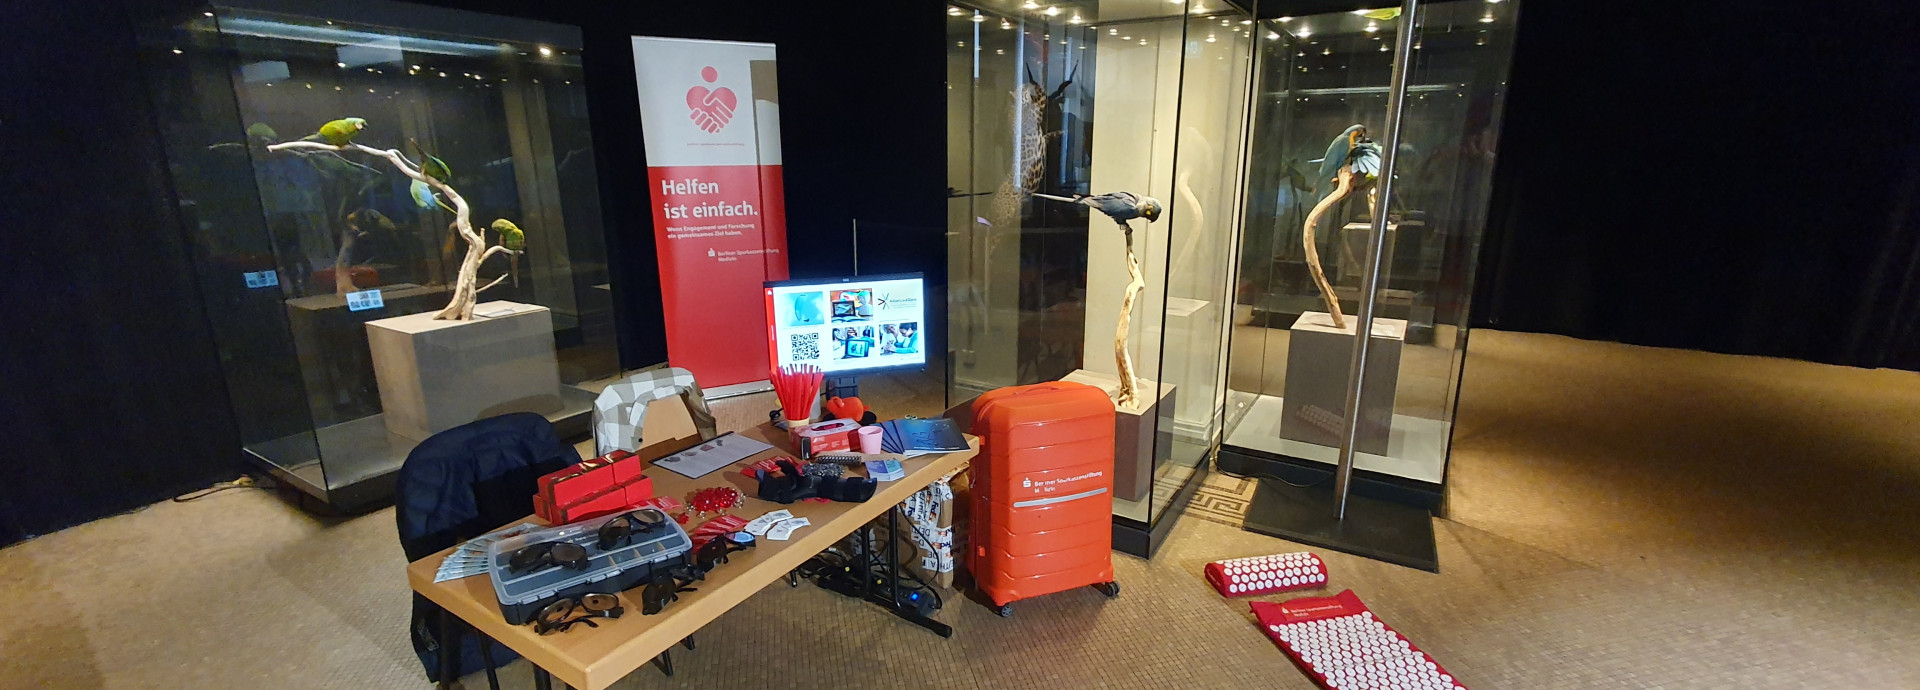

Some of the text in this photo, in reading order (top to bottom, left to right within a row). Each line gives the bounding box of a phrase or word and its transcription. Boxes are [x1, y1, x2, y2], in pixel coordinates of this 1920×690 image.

[661, 178, 719, 196] Helfen
[663, 200, 759, 219] ist einfach.
